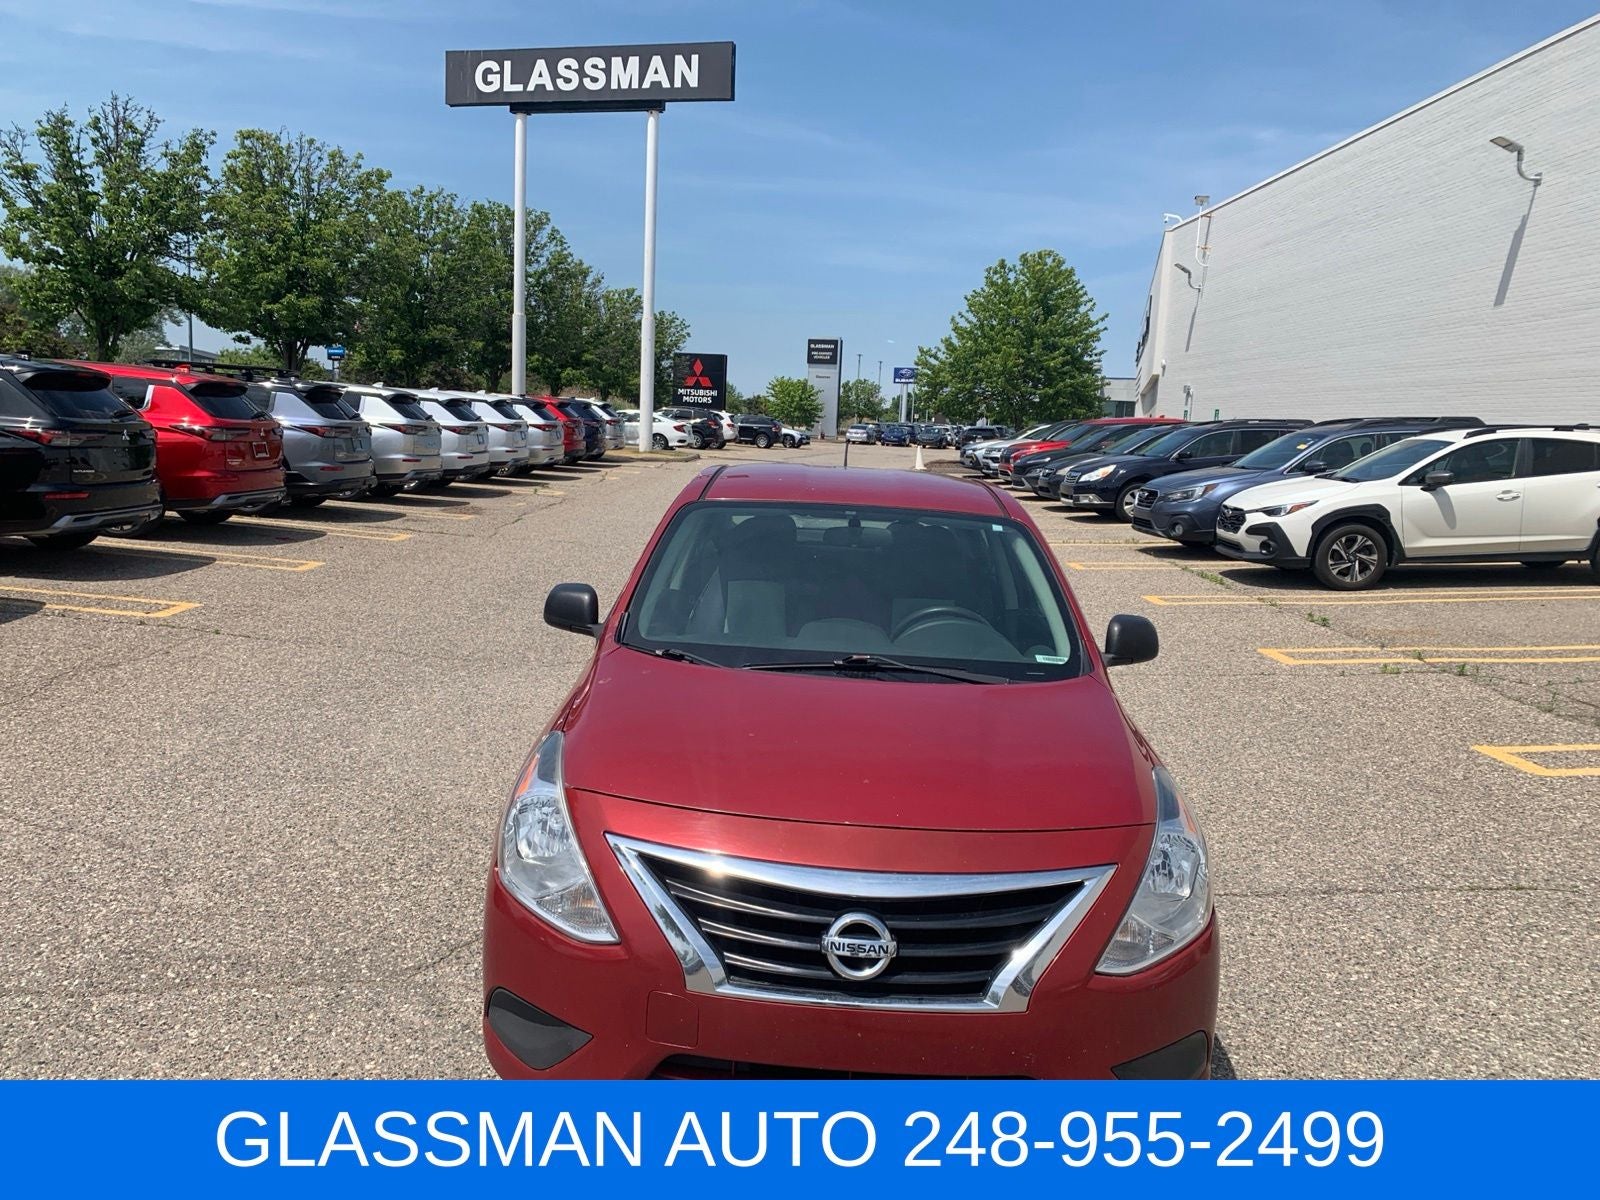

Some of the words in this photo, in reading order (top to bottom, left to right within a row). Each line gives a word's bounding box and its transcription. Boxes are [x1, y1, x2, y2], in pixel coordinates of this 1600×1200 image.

[474, 54, 700, 93] GLASSMAN
[677, 388, 718, 397] MITSUBISHI
[682, 396, 713, 404] MOTORS
[829, 941, 889, 955] NISSAN
